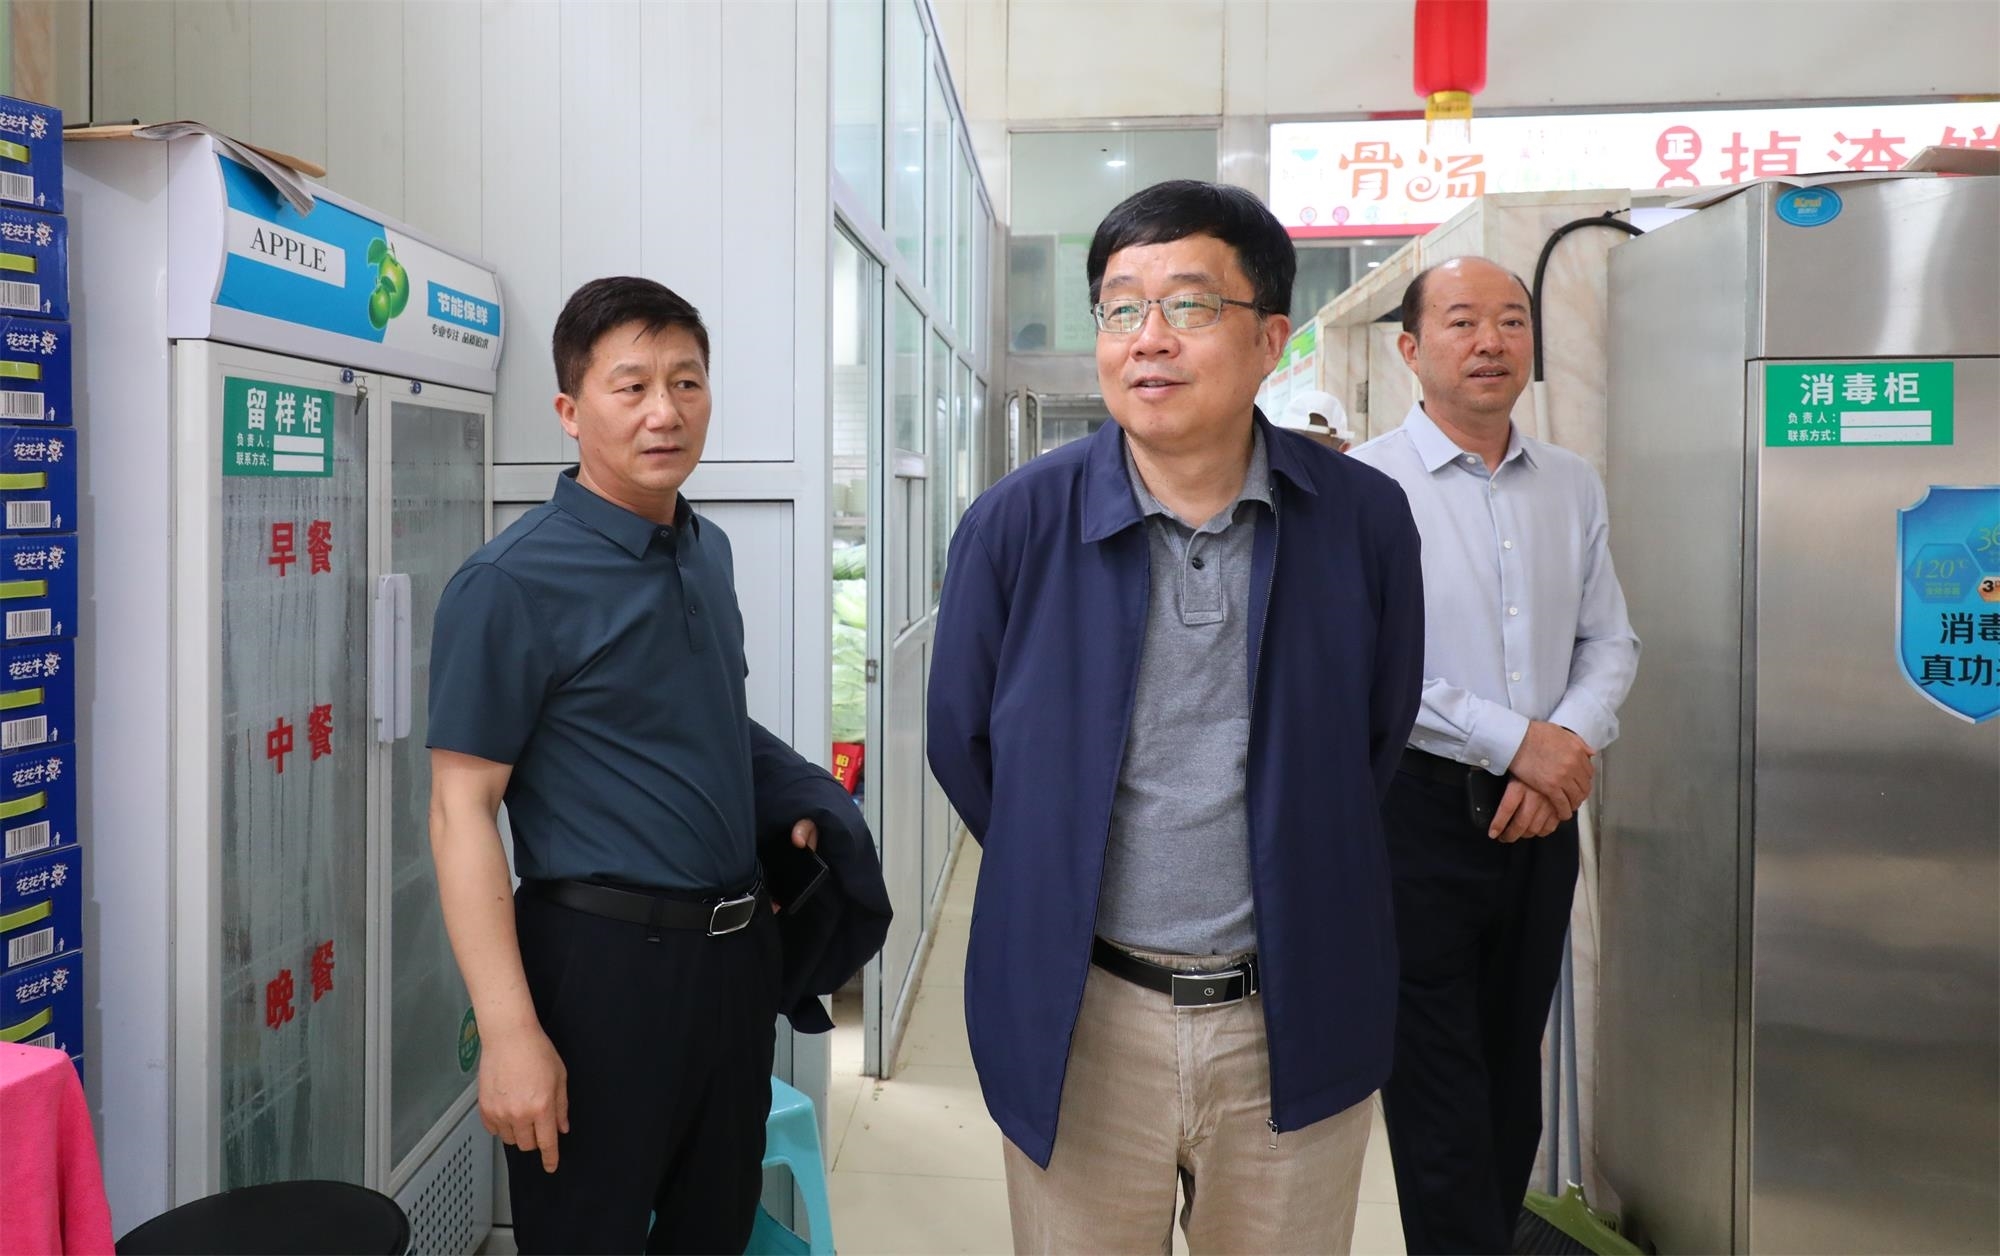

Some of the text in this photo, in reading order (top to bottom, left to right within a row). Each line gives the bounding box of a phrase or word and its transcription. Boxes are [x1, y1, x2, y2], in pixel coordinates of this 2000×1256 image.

[1338, 141, 1486, 202] 骨汤
[250, 227, 327, 272] APPLE
[436, 292, 488, 326] 节能保鲜
[6, 332, 40, 349] 花花牛
[1800, 372, 1920, 405] 消毒柜
[247, 387, 322, 434] 留样柜
[14, 442, 46, 458] 花花牛
[14, 550, 47, 566] 花花牛
[268, 520, 332, 577] 早餐
[1940, 612, 2000, 645] 消毒
[9, 658, 43, 676] 花花牛
[1920, 654, 2000, 687] 真功
[267, 704, 333, 775] 中餐
[12, 764, 45, 784] 花花牛
[16, 871, 50, 892] 花花牛
[16, 977, 50, 1000] 花花牛
[266, 940, 334, 1030] 晚餐
